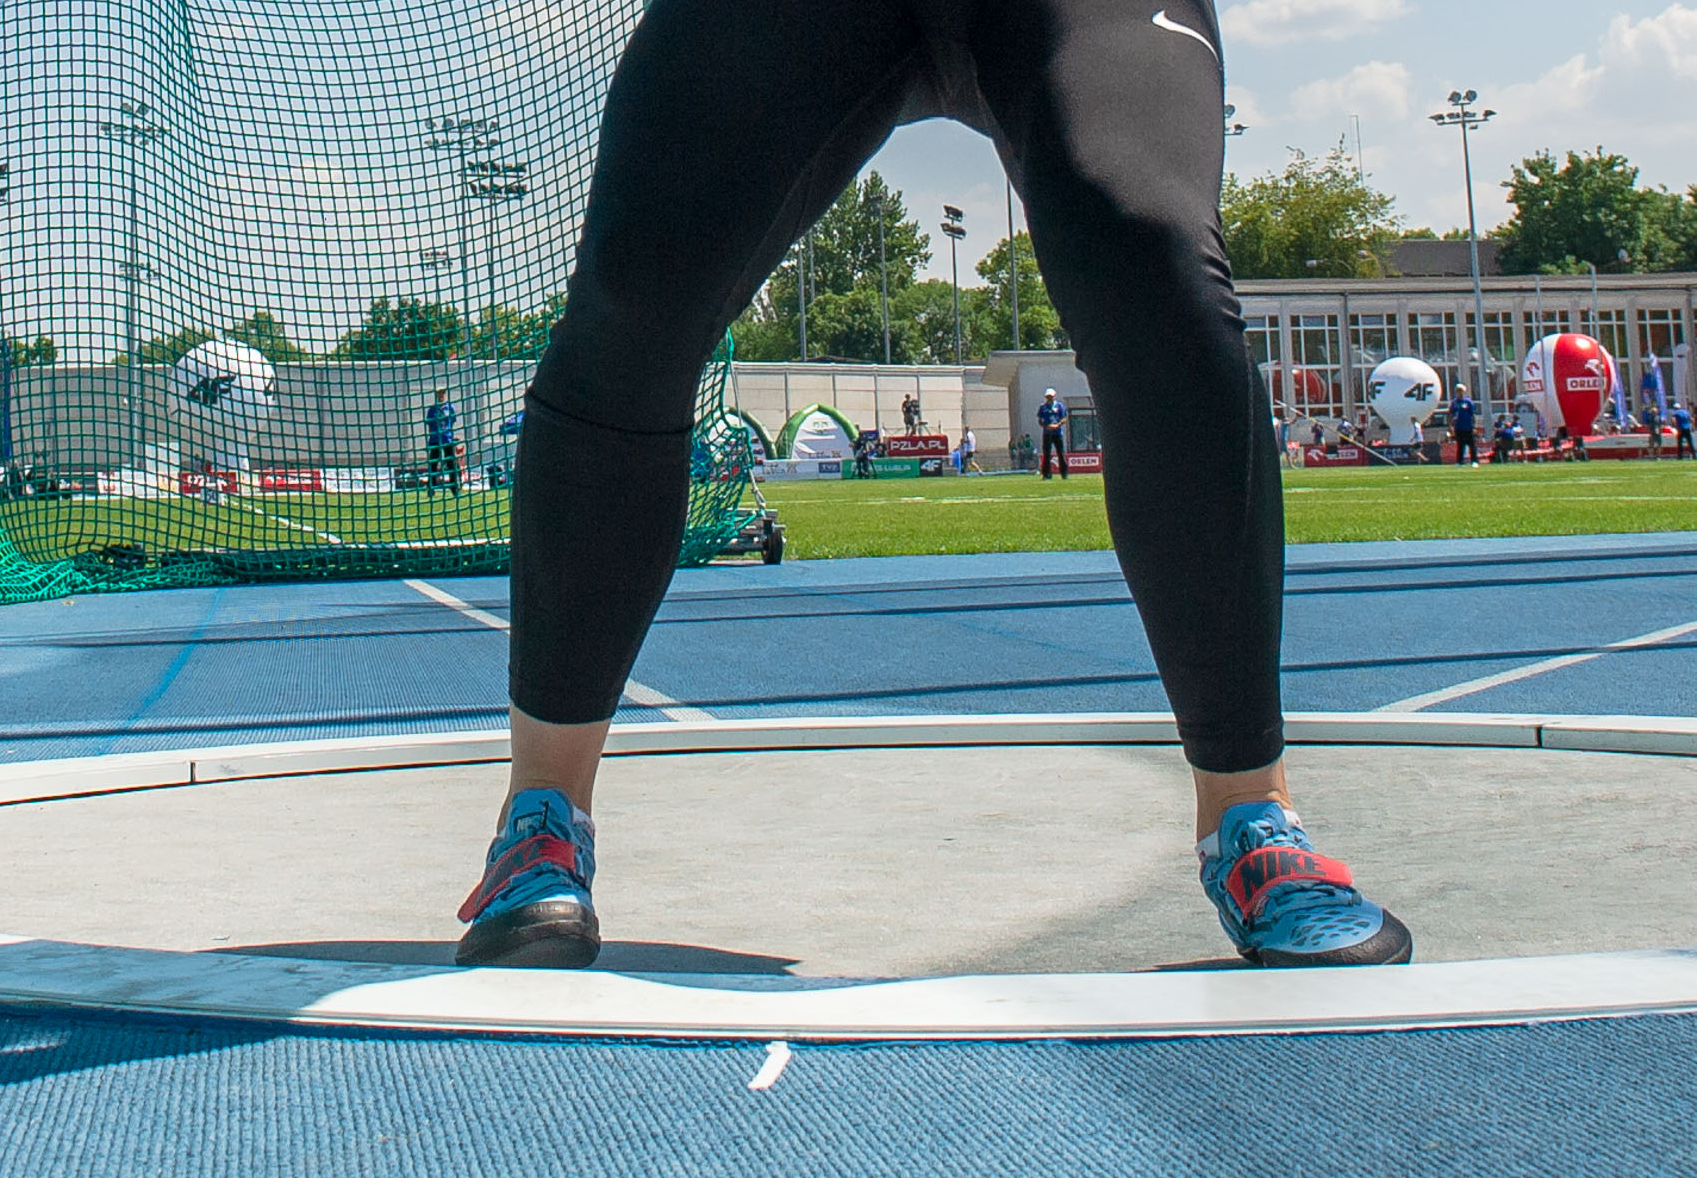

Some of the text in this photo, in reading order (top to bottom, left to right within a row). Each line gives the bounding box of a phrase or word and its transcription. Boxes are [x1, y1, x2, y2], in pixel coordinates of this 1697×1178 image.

[1570, 378, 1602, 389] ORLE
[1404, 382, 1435, 402] 4F
[890, 440, 947, 452] PZLA.PL
[920, 459, 941, 471] 4F
[1239, 850, 1327, 900] NIKE
